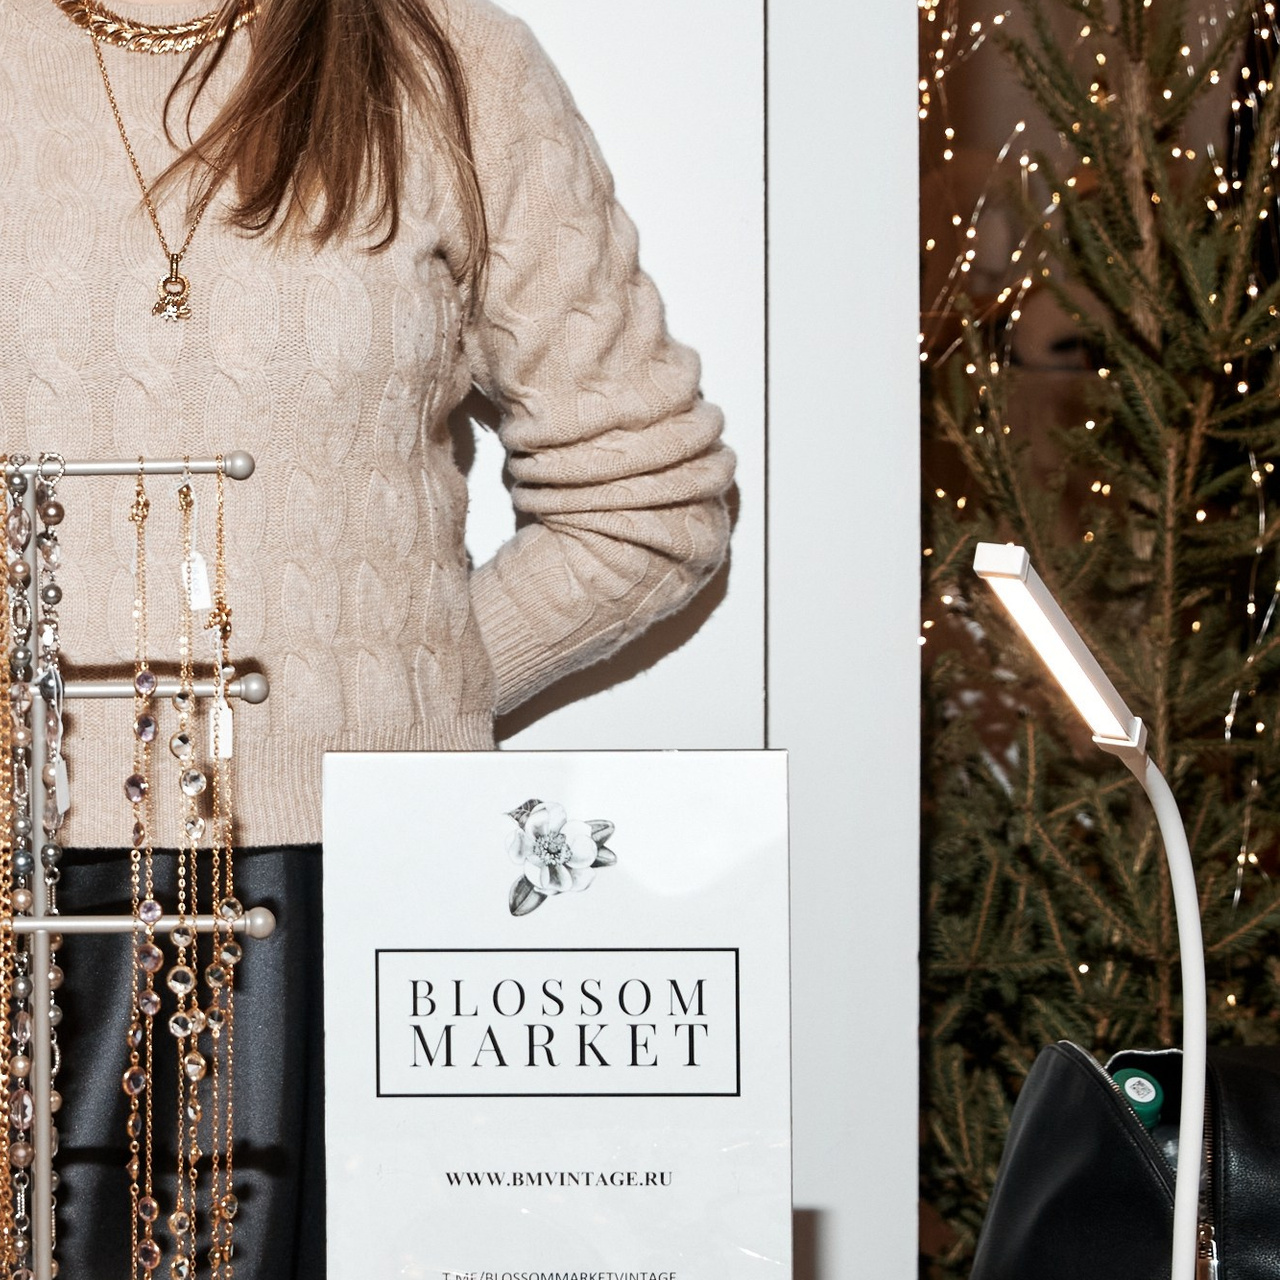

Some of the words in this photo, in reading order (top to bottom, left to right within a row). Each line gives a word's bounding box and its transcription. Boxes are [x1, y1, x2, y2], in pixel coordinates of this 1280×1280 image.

[408, 978, 707, 1018] BLOSSOM
[409, 1023, 709, 1068] MARKET
[445, 1171, 673, 1188] WWW.BMVINTAGE.RU
